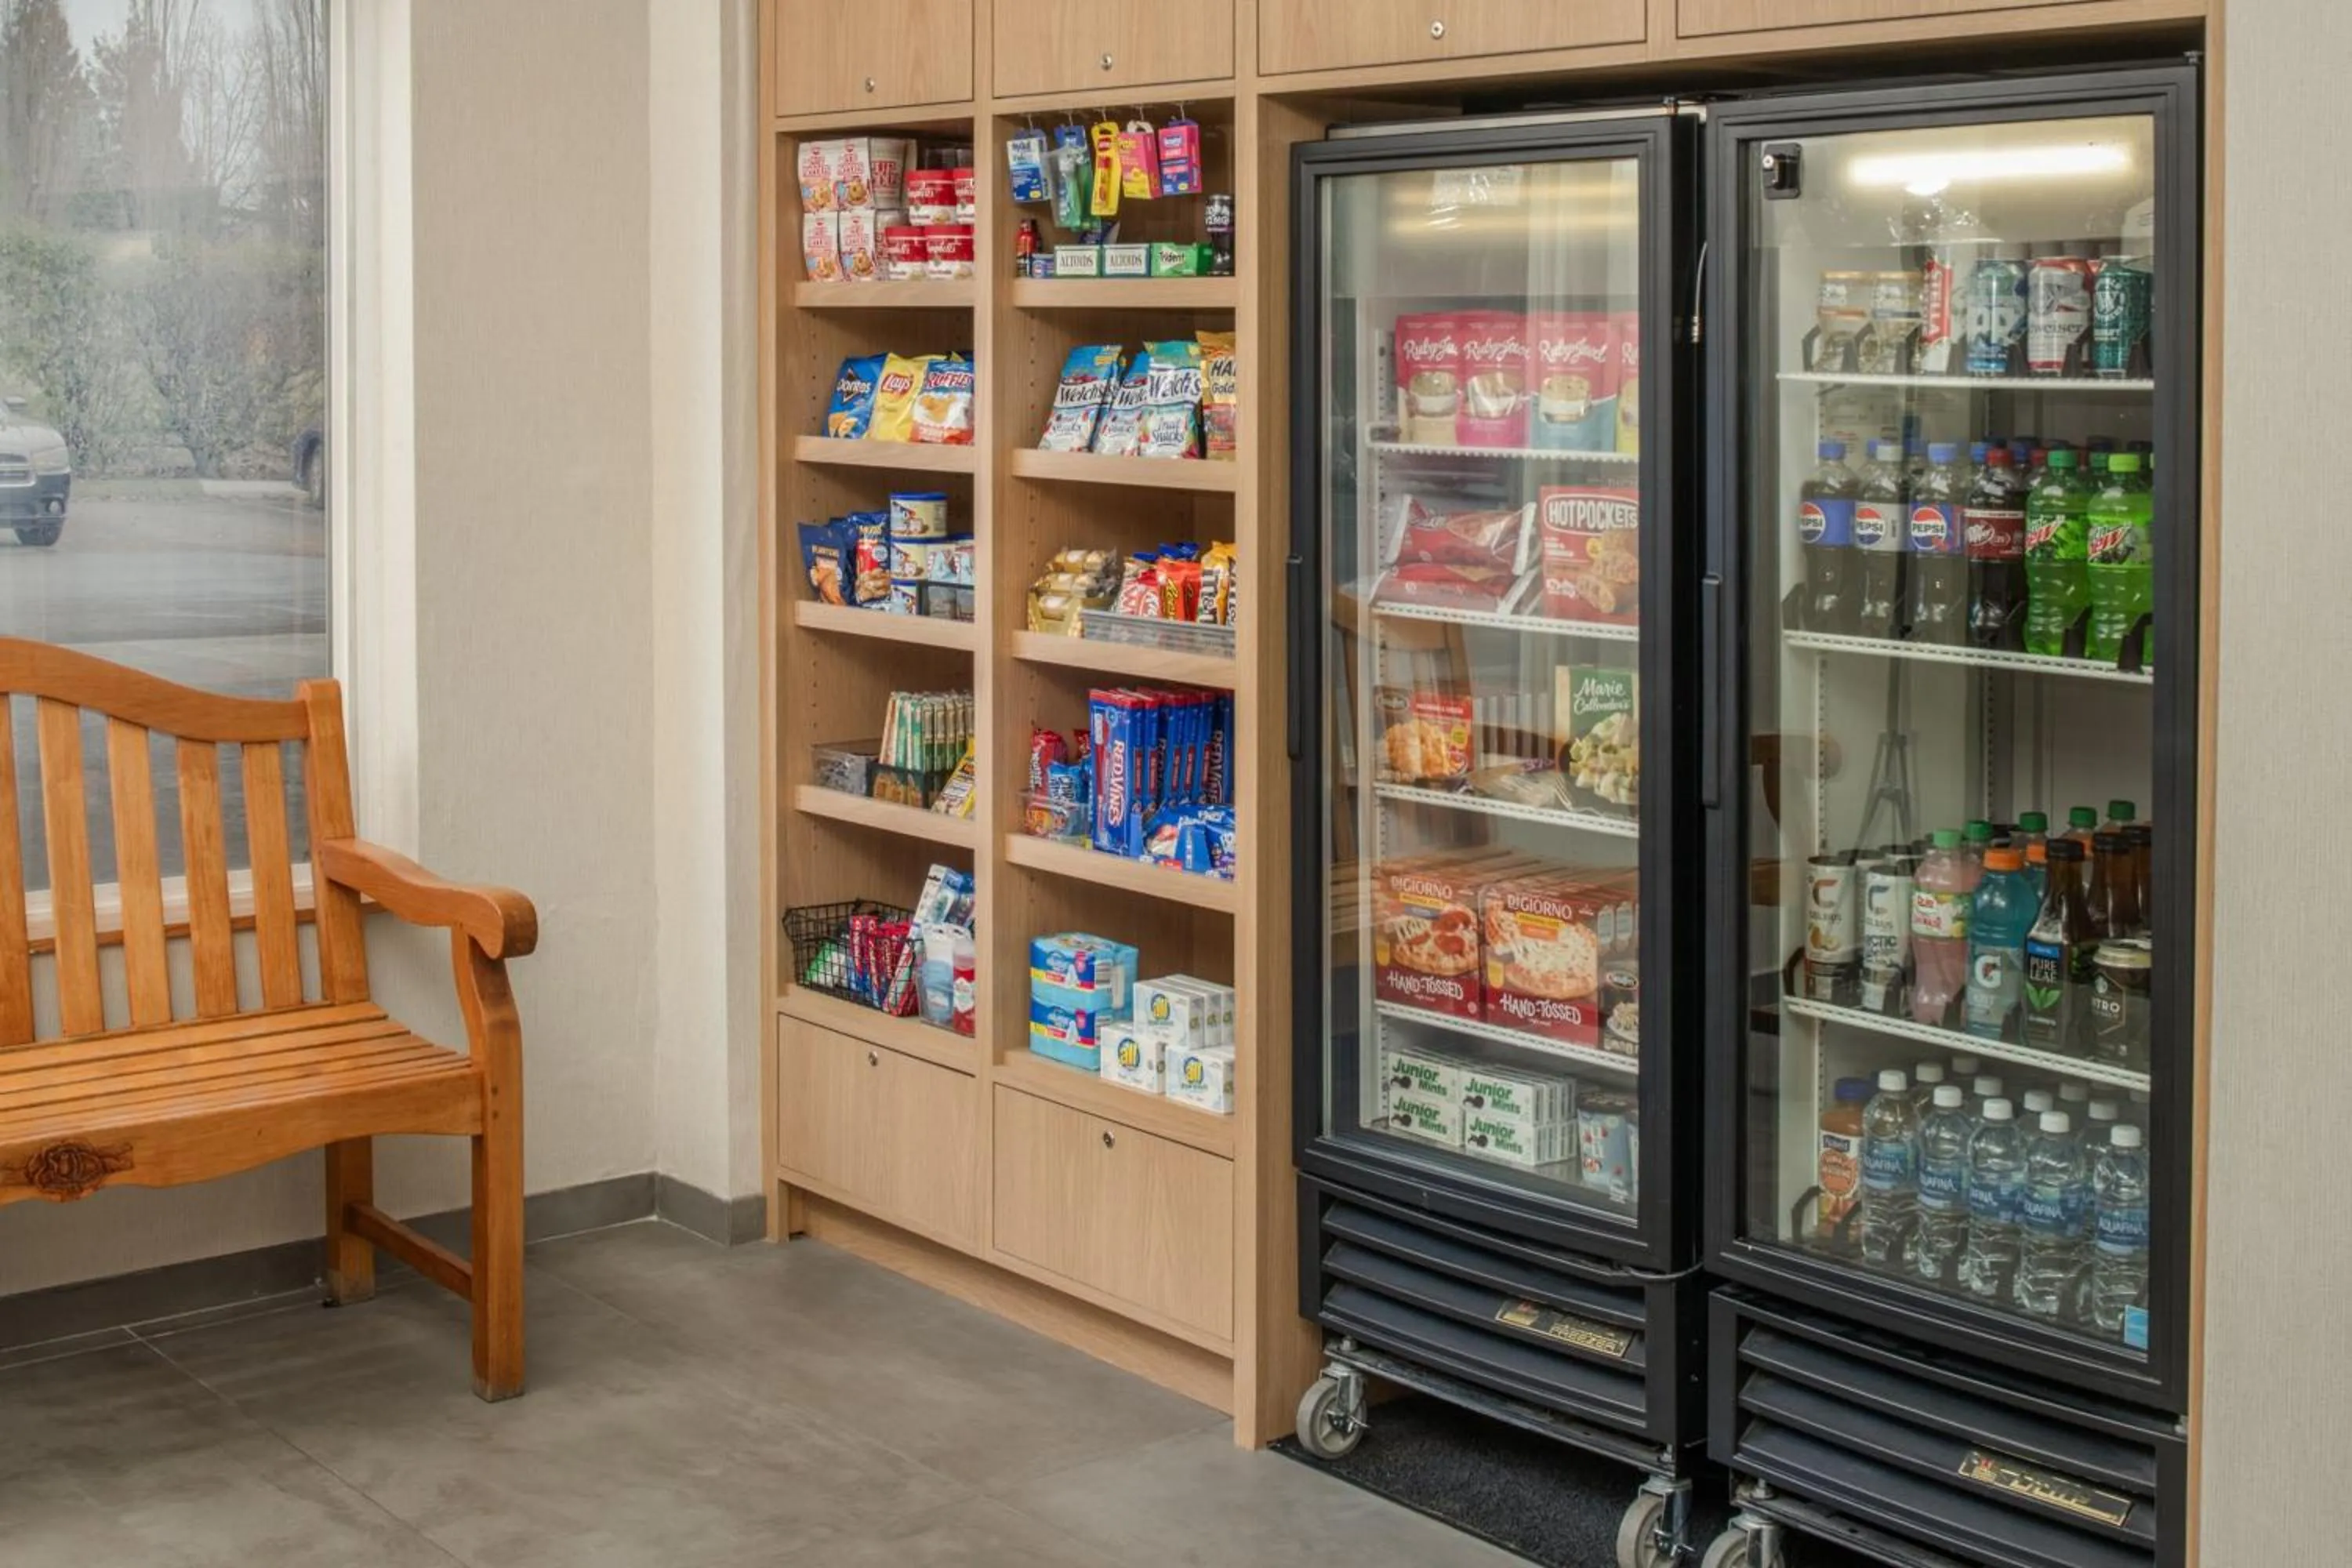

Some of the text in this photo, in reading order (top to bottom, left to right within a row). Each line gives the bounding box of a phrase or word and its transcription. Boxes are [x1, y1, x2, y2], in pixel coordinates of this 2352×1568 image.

[1060, 252, 1094, 267] ALTOIDS
[1109, 252, 1142, 267] ALTOIDS
[1159, 251, 1185, 264] Trident
[1929, 270, 1942, 337] STELLA
[882, 373, 913, 391] Lay's
[1149, 373, 1201, 398] Welch's
[1548, 500, 1574, 527] HOT
[1911, 523, 1945, 534] PEPSI
[1574, 677, 1626, 699] Marie
[1108, 739, 1125, 827] RED VINES
[1391, 876, 1452, 899] DIGIORNO
[1507, 894, 1573, 920] DIGIORNO
[2030, 956, 2057, 971] PURE
[1387, 971, 1465, 1000] HAND-TOSSED
[2029, 968, 2057, 984] LEAF
[1499, 993, 1582, 1025] HAND-TOSSED
[1120, 1039, 1139, 1068] all
[1185, 1058, 1203, 1081] all
[1392, 1057, 1439, 1082] Junior
[1417, 1078, 1448, 1097] Mints
[1464, 1078, 1512, 1099] Junior
[1392, 1097, 1440, 1120] Junior
[1490, 1098, 1521, 1115] Mints
[1417, 1117, 1447, 1135] Mints
[1468, 1116, 1515, 1138] Junior
[1494, 1136, 1523, 1155] Mints
